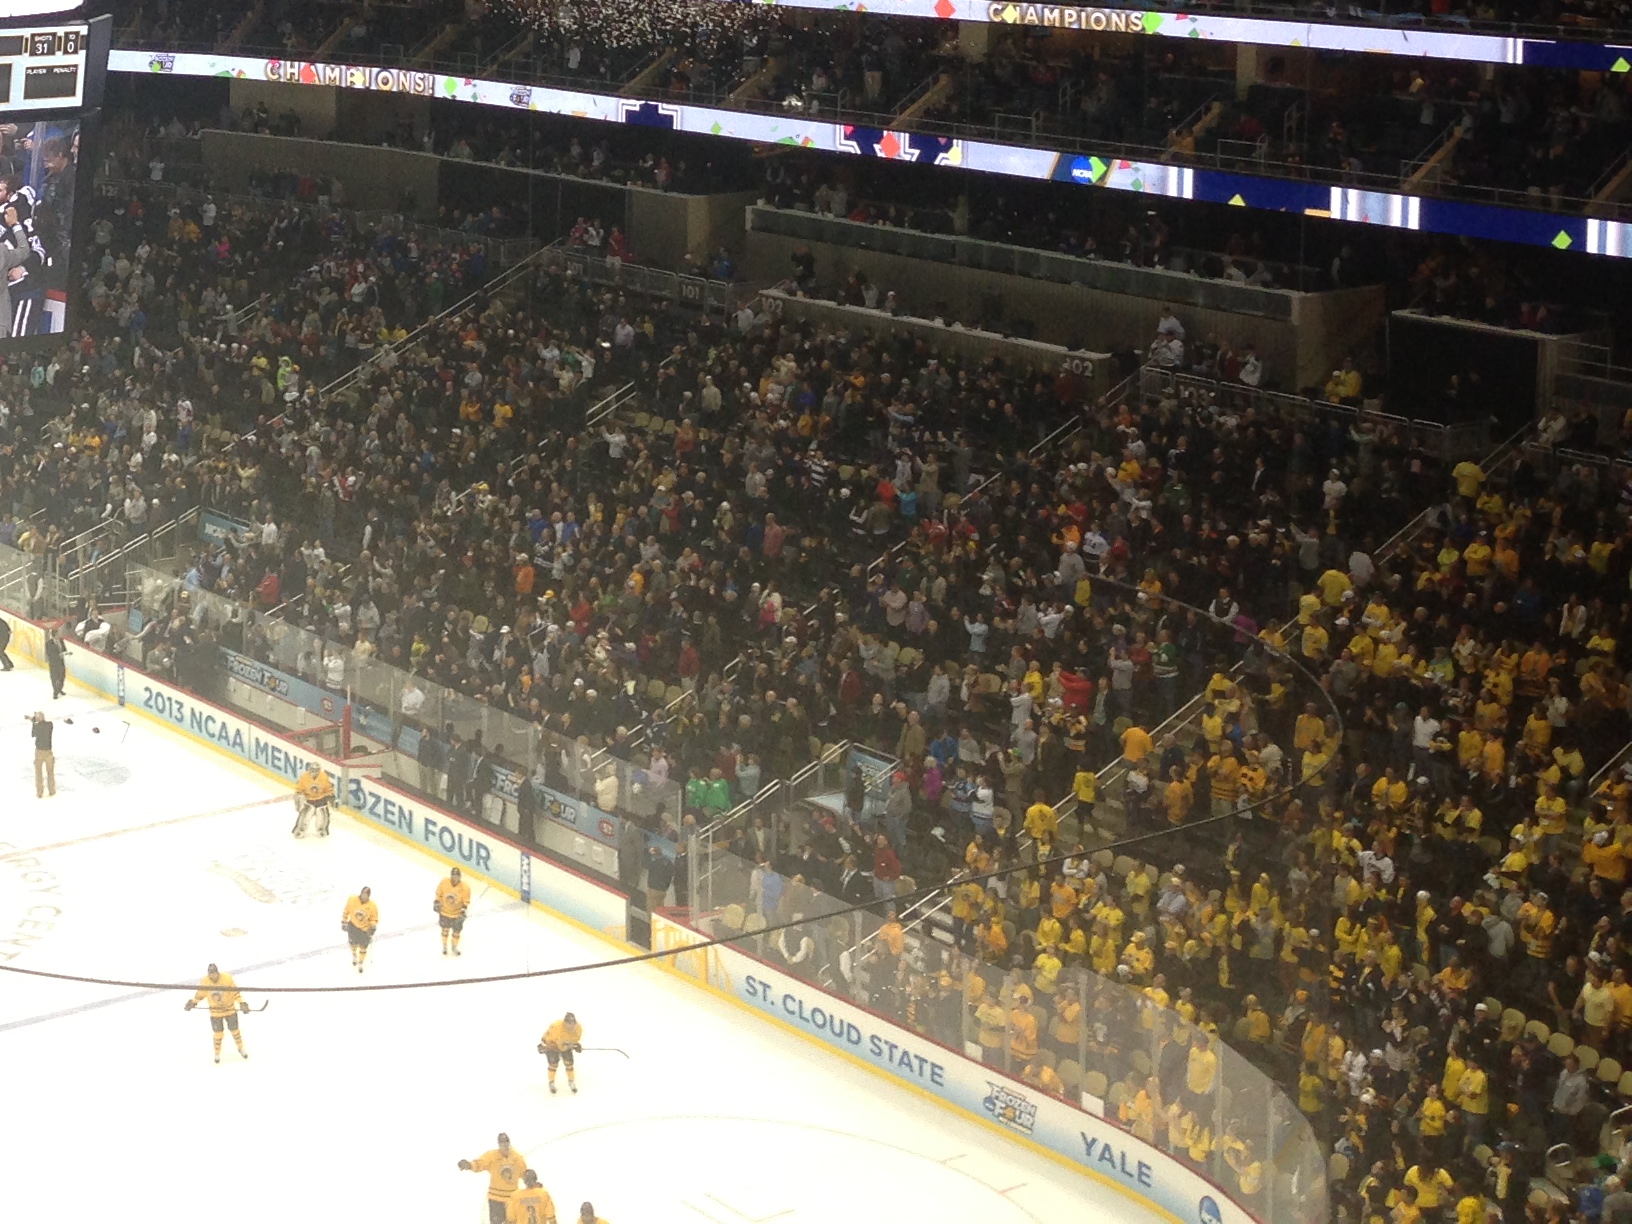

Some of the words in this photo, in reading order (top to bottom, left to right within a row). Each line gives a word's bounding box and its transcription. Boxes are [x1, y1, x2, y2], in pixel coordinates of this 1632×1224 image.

[35, 43, 48, 55] 31
[67, 41, 75, 53] 0
[681, 284, 700, 300] 101
[225, 655, 261, 682] FROZEN
[143, 686, 185, 724] 2013
[189, 711, 245, 753] NCAA
[423, 817, 492, 872] FOUR
[744, 974, 775, 1007] ST.
[781, 992, 863, 1047] CLOUD
[868, 1033, 946, 1089] STATE
[989, 1083, 1037, 1117] FROZEN
[1079, 1129, 1154, 1190] YALE
